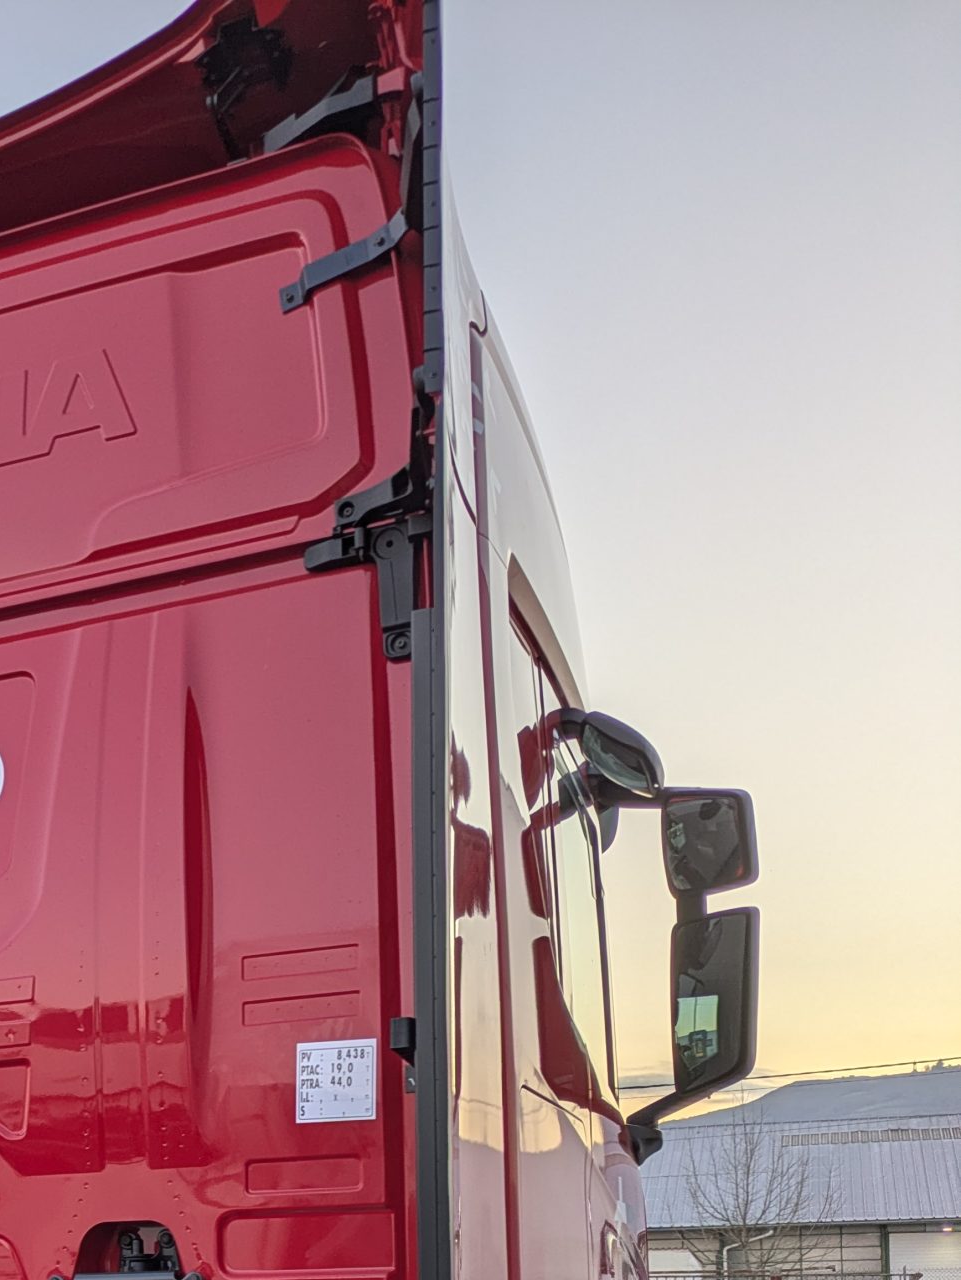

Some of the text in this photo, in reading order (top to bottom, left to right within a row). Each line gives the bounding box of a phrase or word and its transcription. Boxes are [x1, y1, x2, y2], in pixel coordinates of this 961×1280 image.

[301, 1052, 312, 1062] PV
[331, 1062, 353, 1076] 19,0
[330, 1076, 352, 1089] 44,0
[300, 1105, 305, 1117] S
